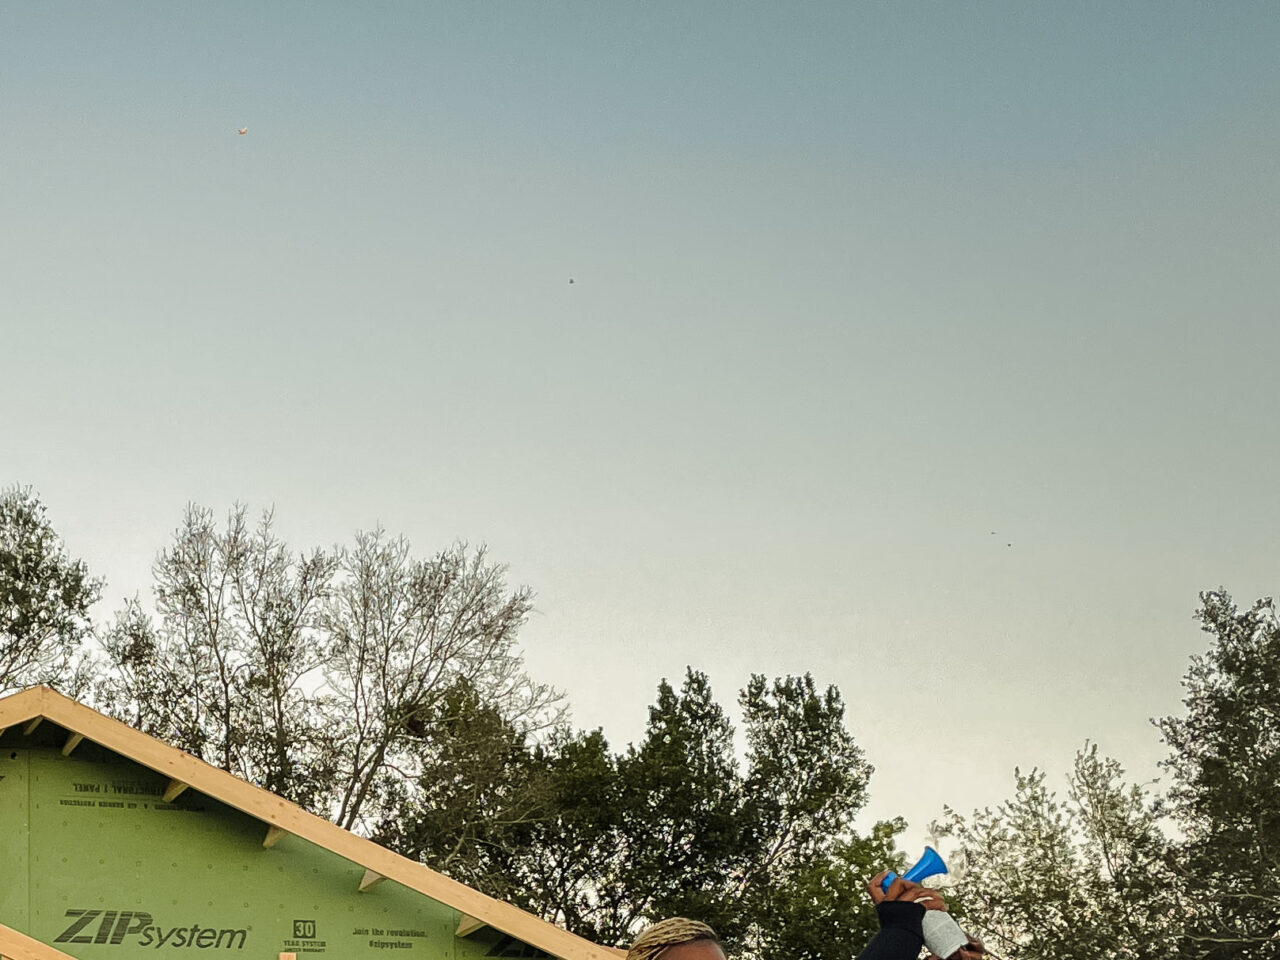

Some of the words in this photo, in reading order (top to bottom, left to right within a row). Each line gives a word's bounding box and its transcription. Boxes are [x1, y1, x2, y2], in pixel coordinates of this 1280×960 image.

[294, 920, 315, 938] 30
[353, 928, 369, 936] Join
[372, 928, 384, 936] the
[369, 941, 413, 949] #zipsystem
